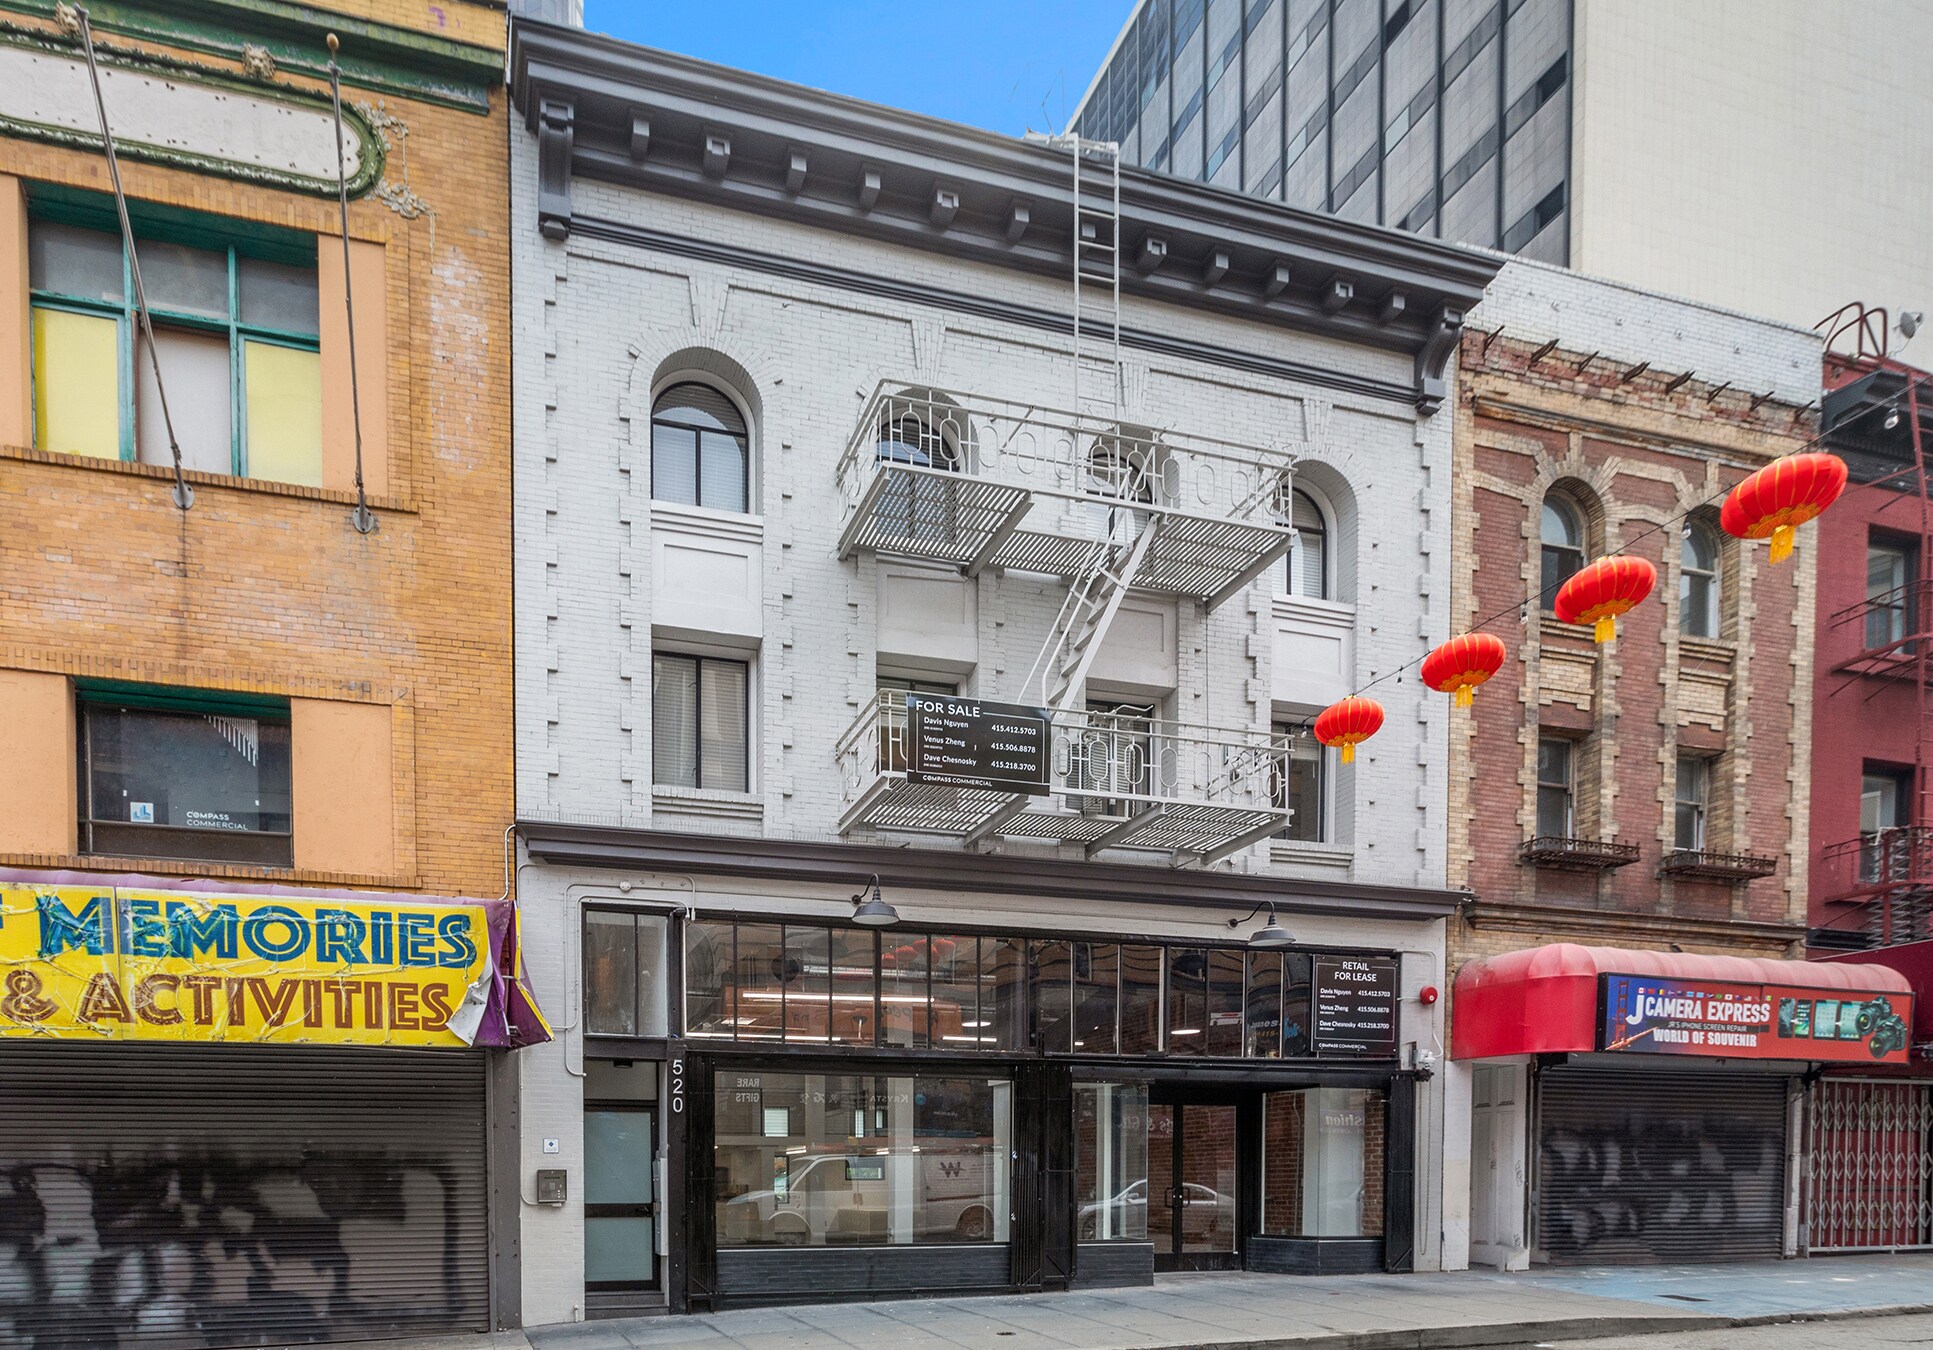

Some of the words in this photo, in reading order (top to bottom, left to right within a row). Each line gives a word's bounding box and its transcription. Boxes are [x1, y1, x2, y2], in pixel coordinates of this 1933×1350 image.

[916, 700, 944, 714] FOR
[948, 704, 980, 718] SALE
[924, 716, 942, 726] Davis
[944, 718, 969, 729] Nguyen
[992, 724, 1036, 736] 415.412.5703
[924, 735, 944, 744] Venus
[945, 738, 966, 748] Zheng
[990, 742, 1036, 754] 415.506.8878
[924, 754, 940, 763] Dave
[942, 756, 977, 768] Chesnosky
[990, 760, 1036, 772] 415.218.3700
[922, 774, 952, 784] COMPASS
[952, 777, 993, 787] COMMERCIAL
[186, 811, 230, 821] COMPASS
[186, 819, 248, 831] COMMERCIAL
[37, 895, 478, 969] MEMORIES
[1342, 961, 1370, 971] RETAIL
[1334, 971, 1352, 981] FOR
[1352, 972, 1377, 982] LEASE
[1, 969, 60, 1023] &
[78, 971, 454, 1032] ACTIVITIES
[1646, 996, 1702, 1019] CAMERA
[1707, 1001, 1770, 1023] EXPRESS
[1703, 1023, 1726, 1031] SCREEN
[1653, 1029, 1690, 1043] WORLD
[1692, 1031, 1705, 1044] OF
[1707, 1032, 1757, 1047] SOUVENIR
[672, 1059, 684, 1114] 520
